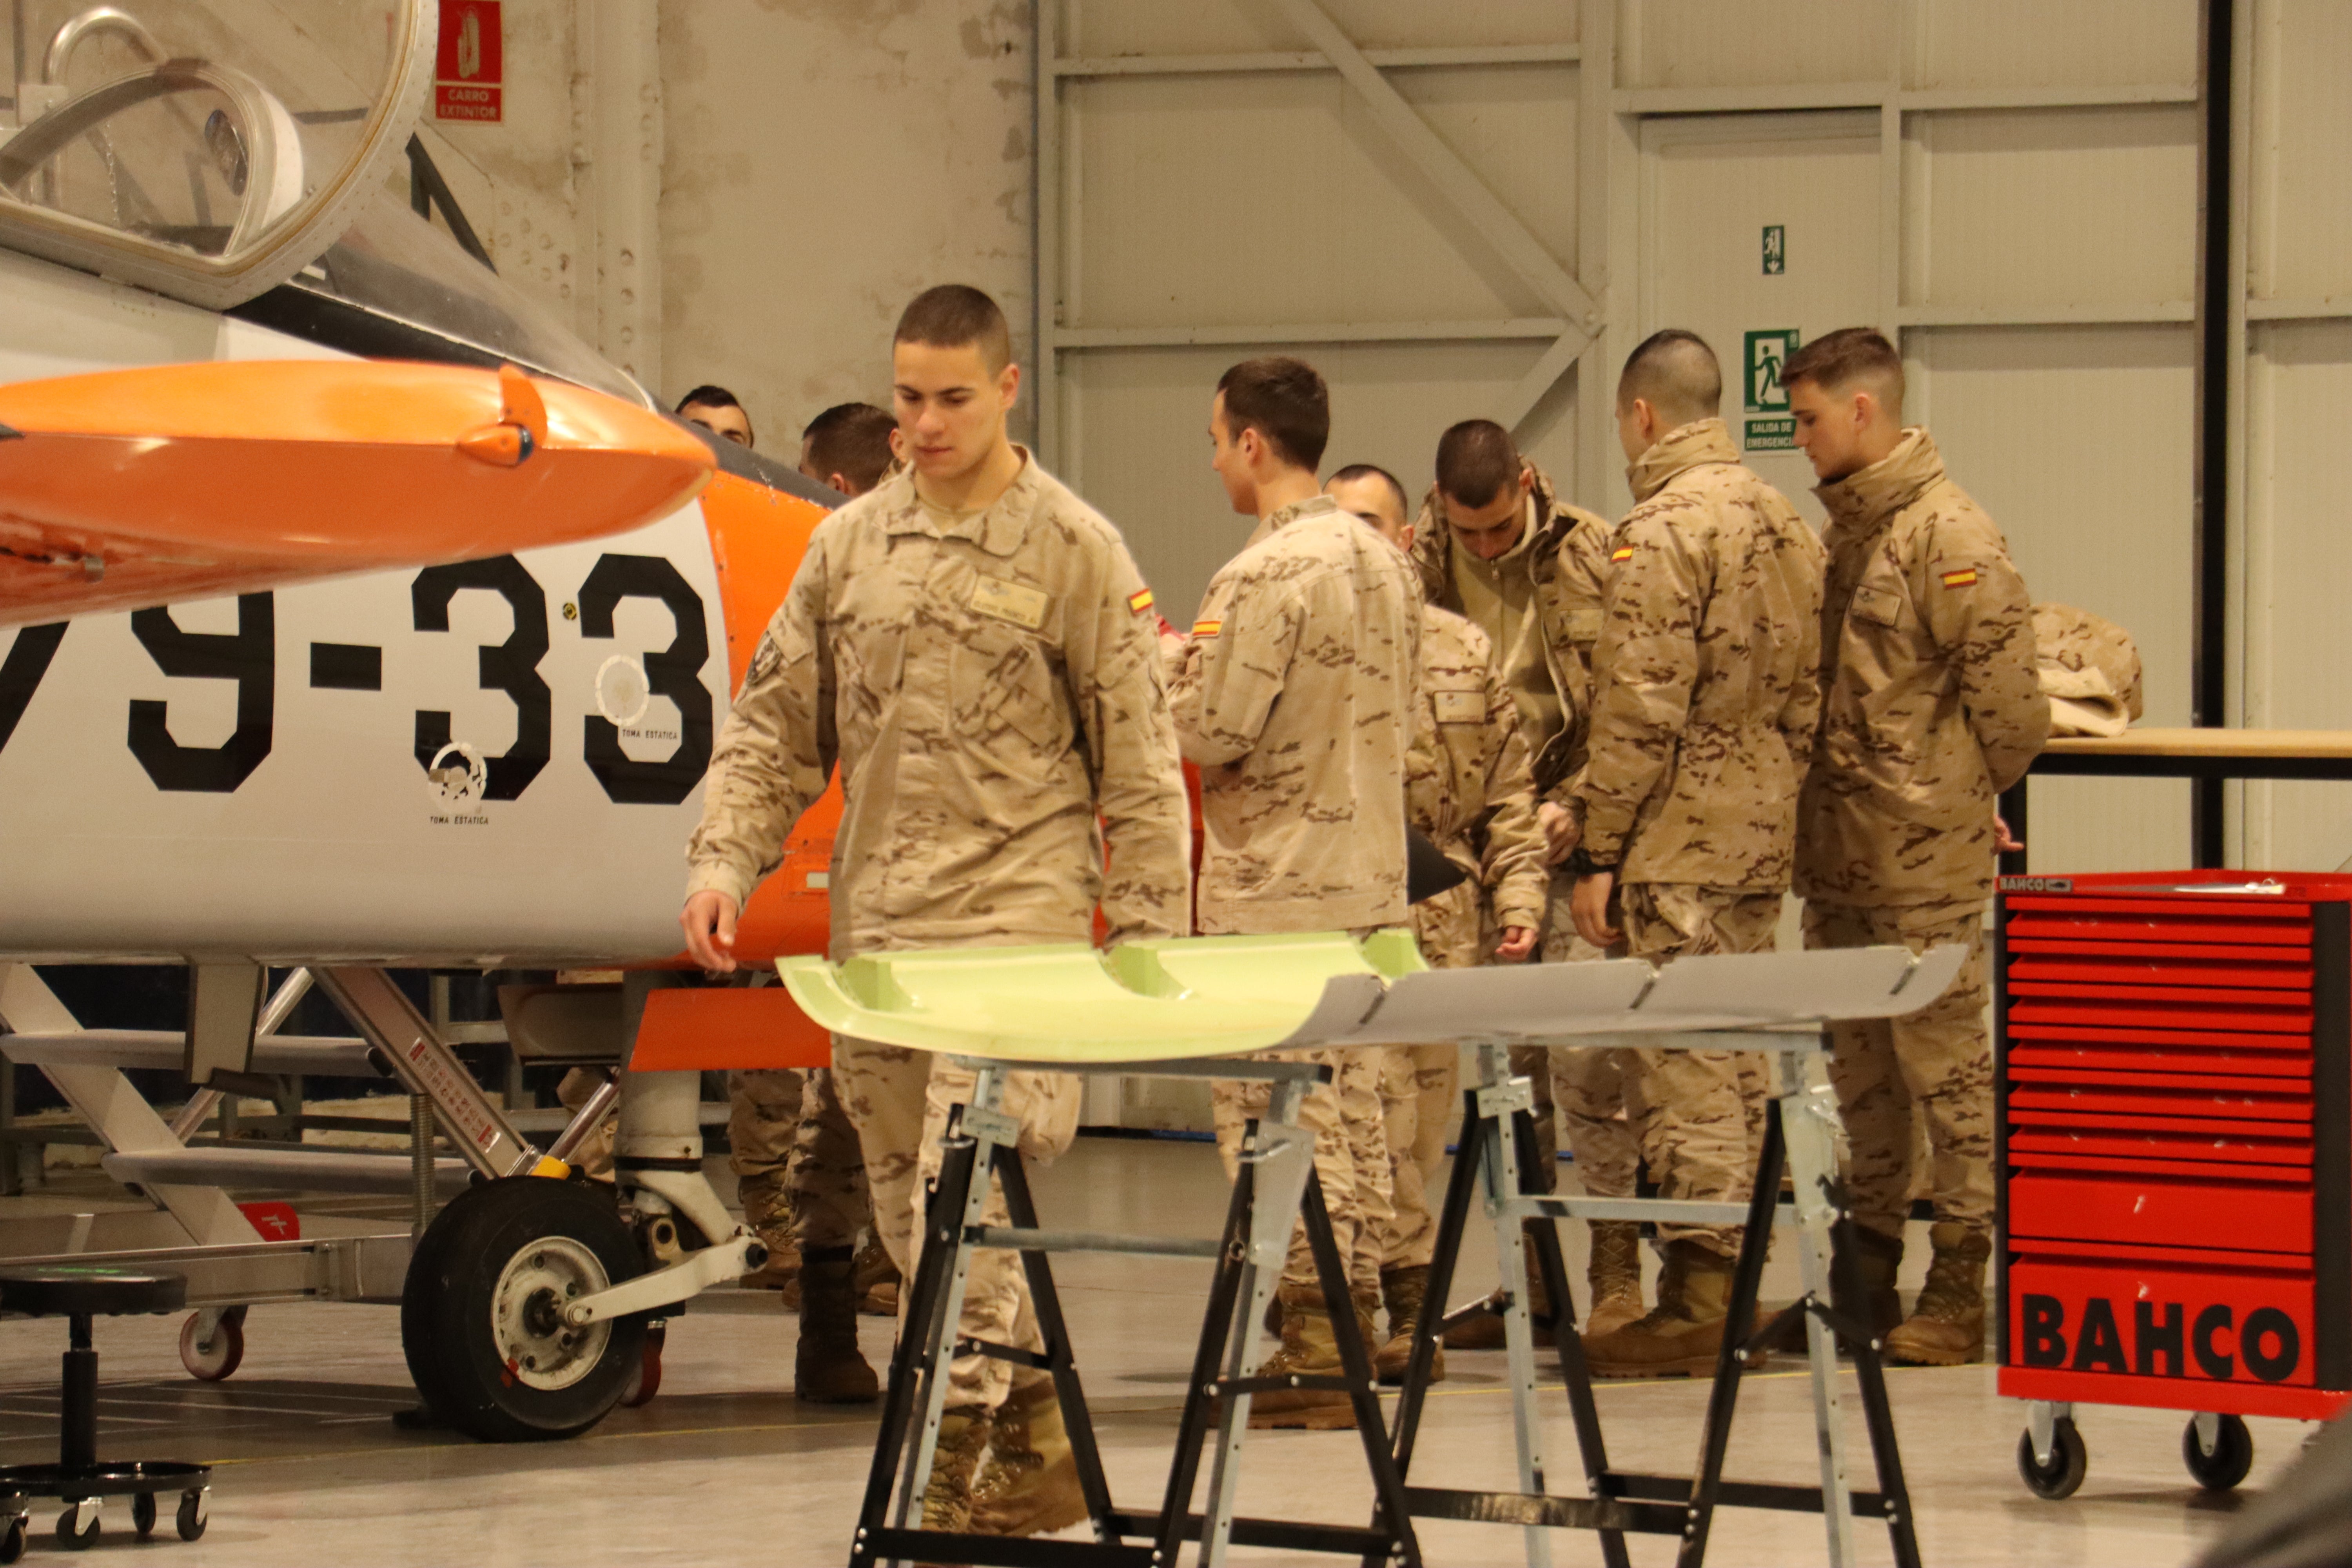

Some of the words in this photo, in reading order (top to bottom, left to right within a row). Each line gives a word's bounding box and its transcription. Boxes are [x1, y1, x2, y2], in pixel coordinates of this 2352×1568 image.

[448, 89, 489, 102] CARRO
[440, 104, 496, 118] EXTINTOR
[1752, 422, 1779, 434] SALIDA
[1781, 421, 1791, 432] DE
[1746, 437, 1793, 448] EMERGENCI
[622, 729, 640, 738] TOMA
[646, 730, 677, 740] ESTATICA
[454, 815, 488, 824] ESTATICA
[2000, 877, 2044, 891] BAHCO
[2022, 1293, 2300, 1383] BAHCO
